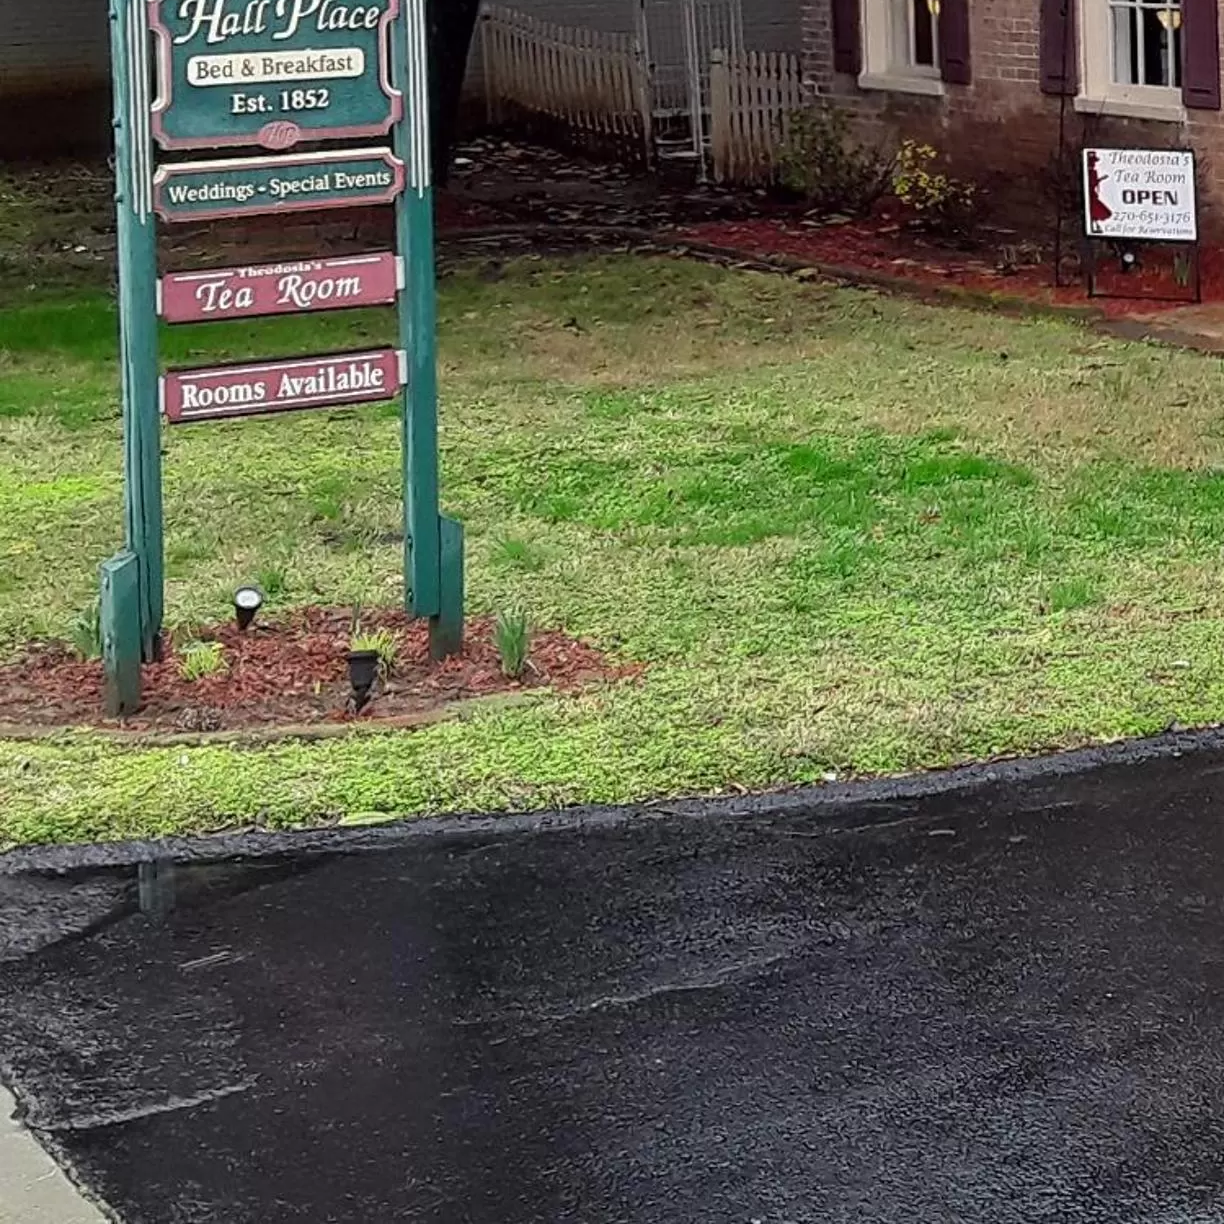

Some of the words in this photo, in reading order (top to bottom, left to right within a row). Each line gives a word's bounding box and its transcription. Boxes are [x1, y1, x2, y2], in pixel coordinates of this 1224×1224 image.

[195, 60, 234, 80] Bed
[240, 59, 256, 77] &
[261, 53, 354, 76] Breakfast
[230, 93, 274, 114] Est.
[281, 89, 330, 111] 1852
[1108, 151, 1190, 166] Theodosia's
[168, 182, 255, 204] Weddings
[269, 175, 330, 198] Special
[334, 171, 391, 191] Events
[1113, 169, 1139, 183] Tea
[1143, 170, 1186, 184] Room
[1121, 189, 1179, 206] OPEN
[1112, 210, 1191, 225] 270-651-3176
[196, 279, 253, 312] Tea
[276, 275, 362, 308] Room
[181, 381, 265, 409] Rooms
[277, 362, 384, 398] Available
